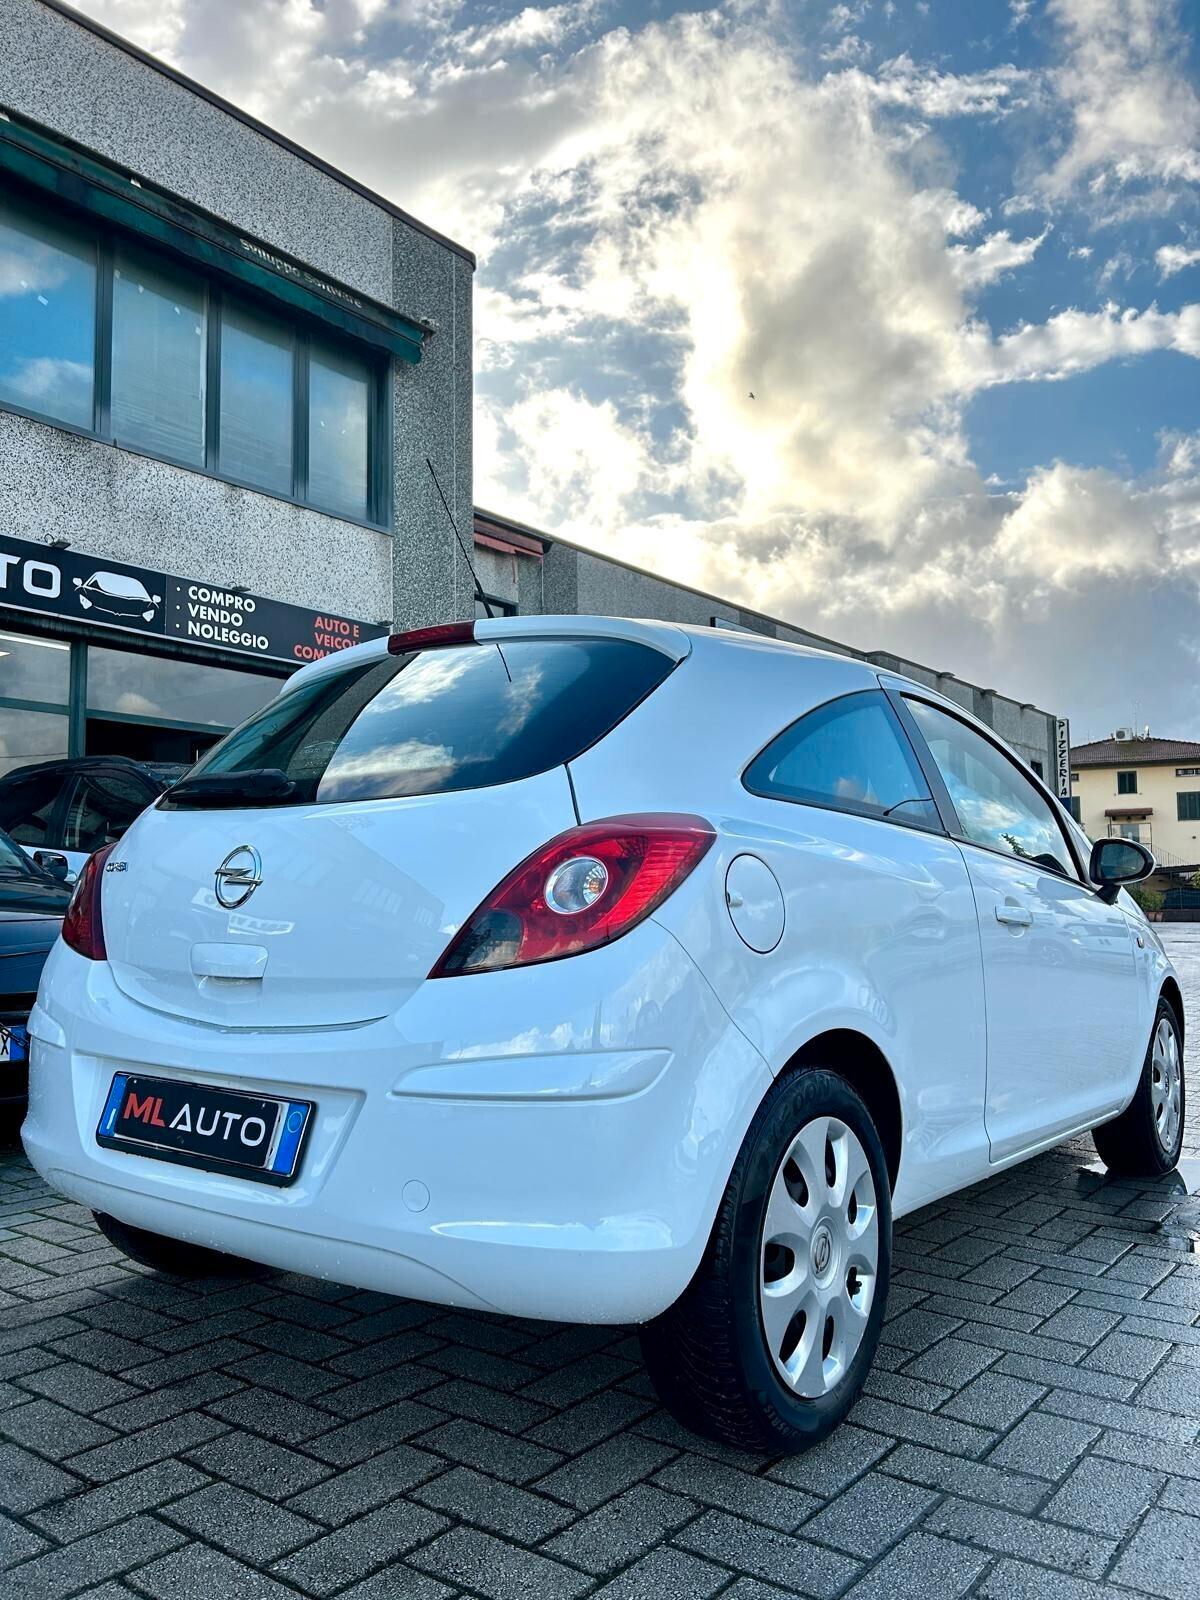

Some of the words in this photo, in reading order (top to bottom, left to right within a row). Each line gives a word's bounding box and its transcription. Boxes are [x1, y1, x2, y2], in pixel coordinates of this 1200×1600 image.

[188, 585, 256, 613] COMPRO
[187, 602, 243, 627] VENDO
[314, 616, 350, 635] AUTO
[353, 624, 361, 638] E
[187, 620, 269, 650] NOLEGGIO
[314, 632, 361, 650] VEICO
[1058, 720, 1068, 797] PIZZERIA
